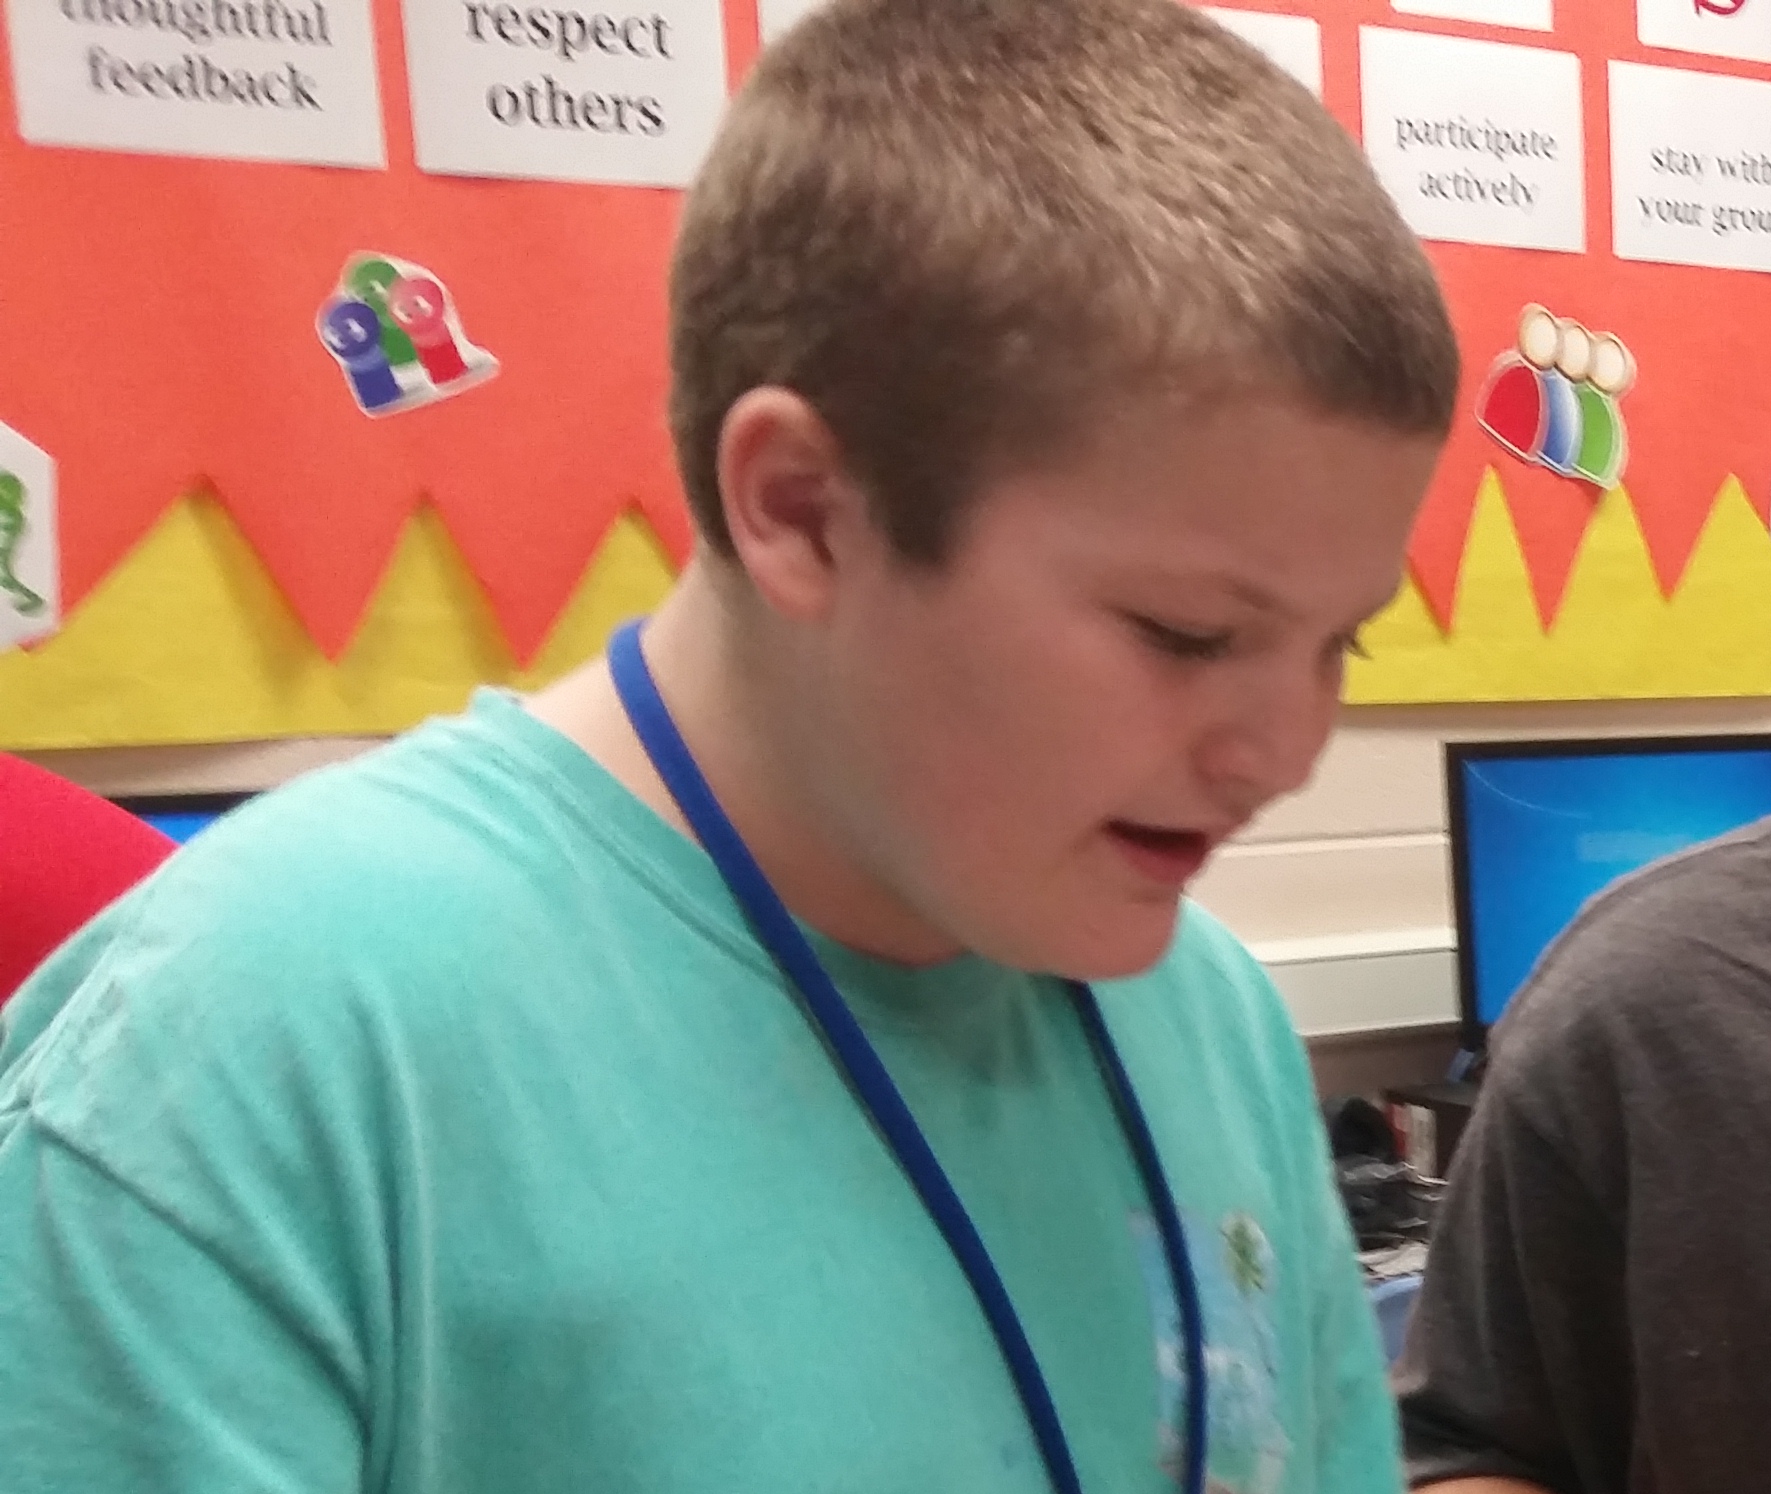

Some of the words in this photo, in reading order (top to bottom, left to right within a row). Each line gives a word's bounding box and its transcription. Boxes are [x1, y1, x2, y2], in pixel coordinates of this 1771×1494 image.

[463, 0, 675, 63] respect
[86, 46, 325, 112] feedback
[486, 74, 669, 137] others
[1395, 114, 1559, 161] participate
[1651, 147, 1709, 184] stay
[1419, 167, 1541, 215] actively
[1637, 197, 1705, 228] your
